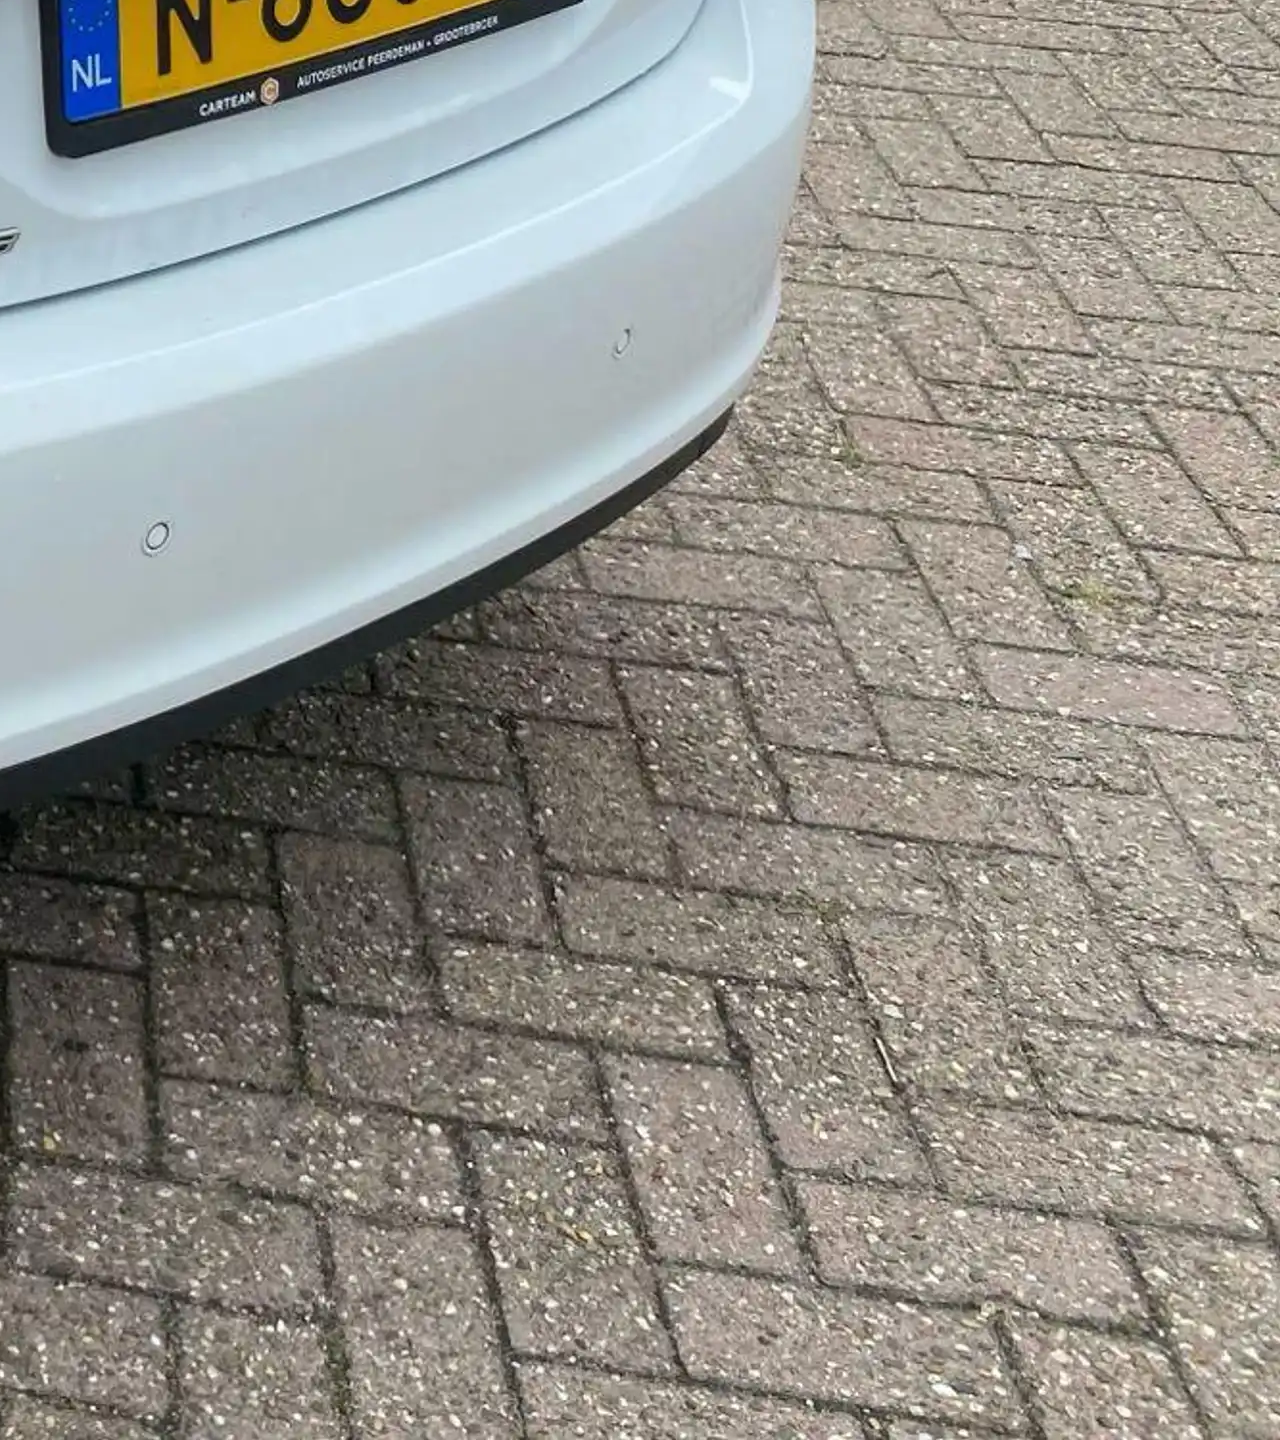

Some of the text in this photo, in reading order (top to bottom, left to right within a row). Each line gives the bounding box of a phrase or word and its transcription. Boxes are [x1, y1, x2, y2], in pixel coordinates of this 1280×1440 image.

[71, 52, 112, 93] NL
[198, 15, 499, 117] CARTEAM AUTOSERVICE PEERDEMAN GROOTEBROEK
